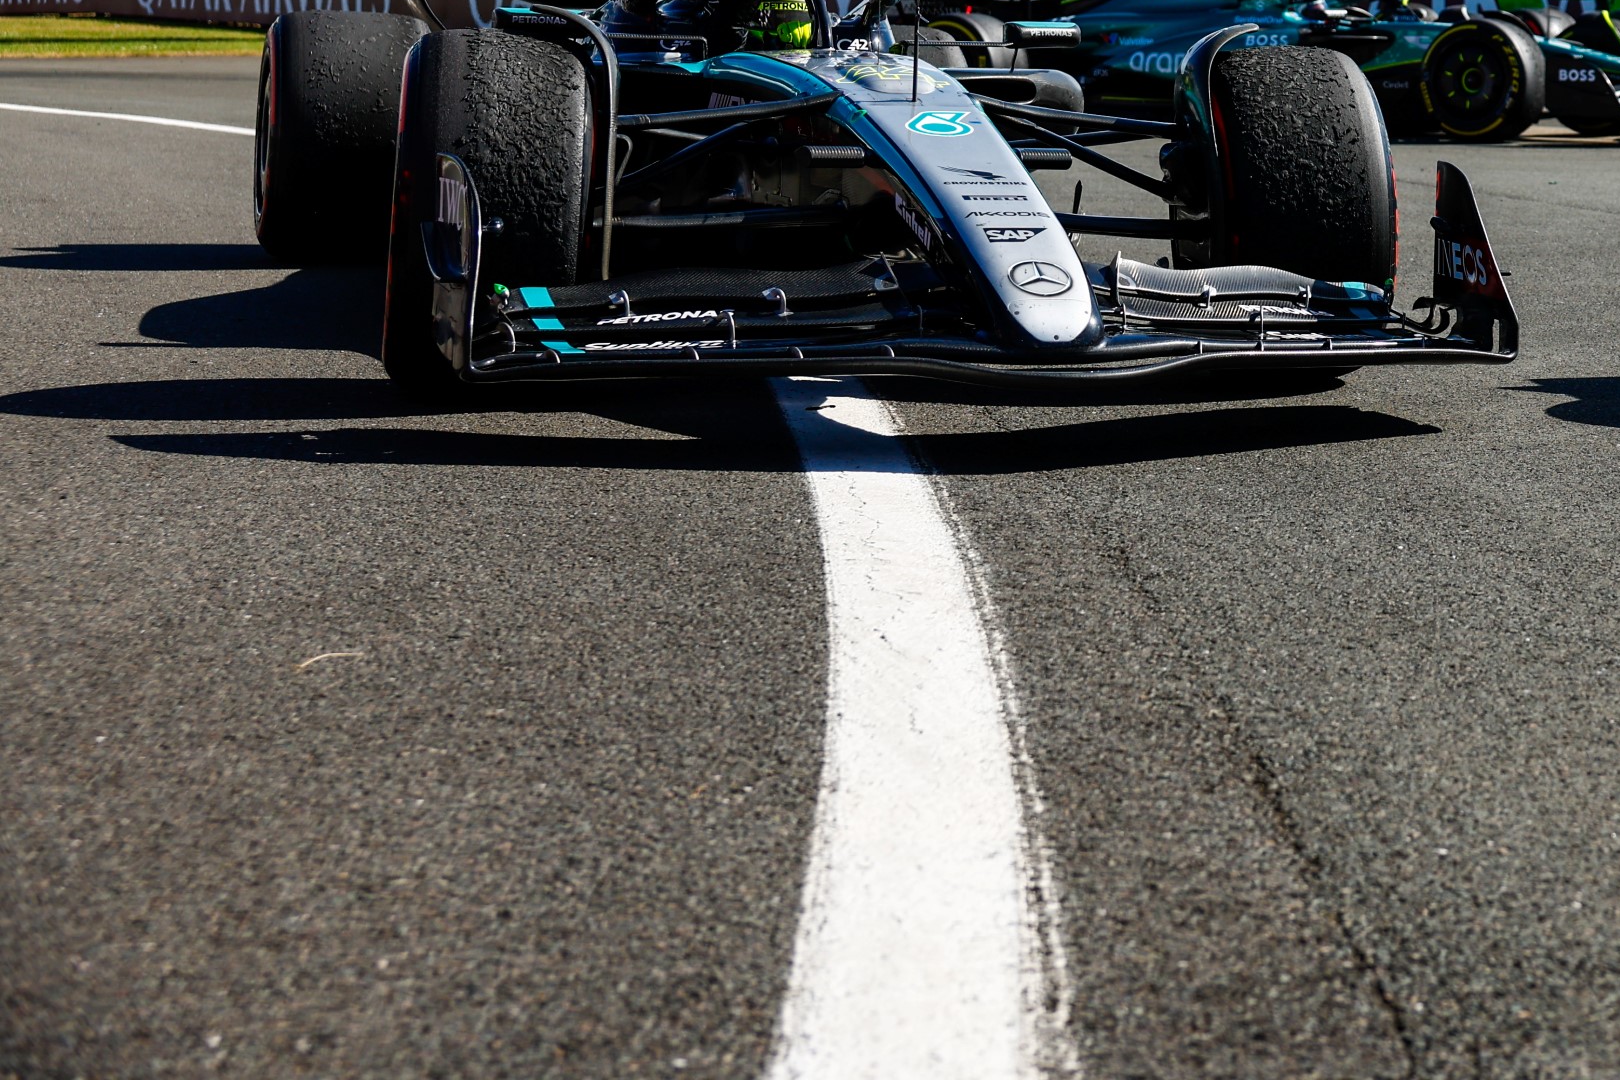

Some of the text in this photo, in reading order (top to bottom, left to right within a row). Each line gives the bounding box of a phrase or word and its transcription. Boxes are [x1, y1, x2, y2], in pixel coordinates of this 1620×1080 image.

[763, 1, 808, 10] PETRONA
[512, 14, 568, 25] PETRONAS
[1030, 30, 1073, 38] PETRONAS
[1245, 34, 1289, 47] BOSS
[1557, 68, 1597, 83] BOSS
[961, 194, 1028, 202] PIRELLI
[964, 211, 1051, 219] AKKODIS
[894, 191, 932, 252] Einhell
[986, 229, 1036, 241] SAP
[1436, 237, 1488, 286] INEOS
